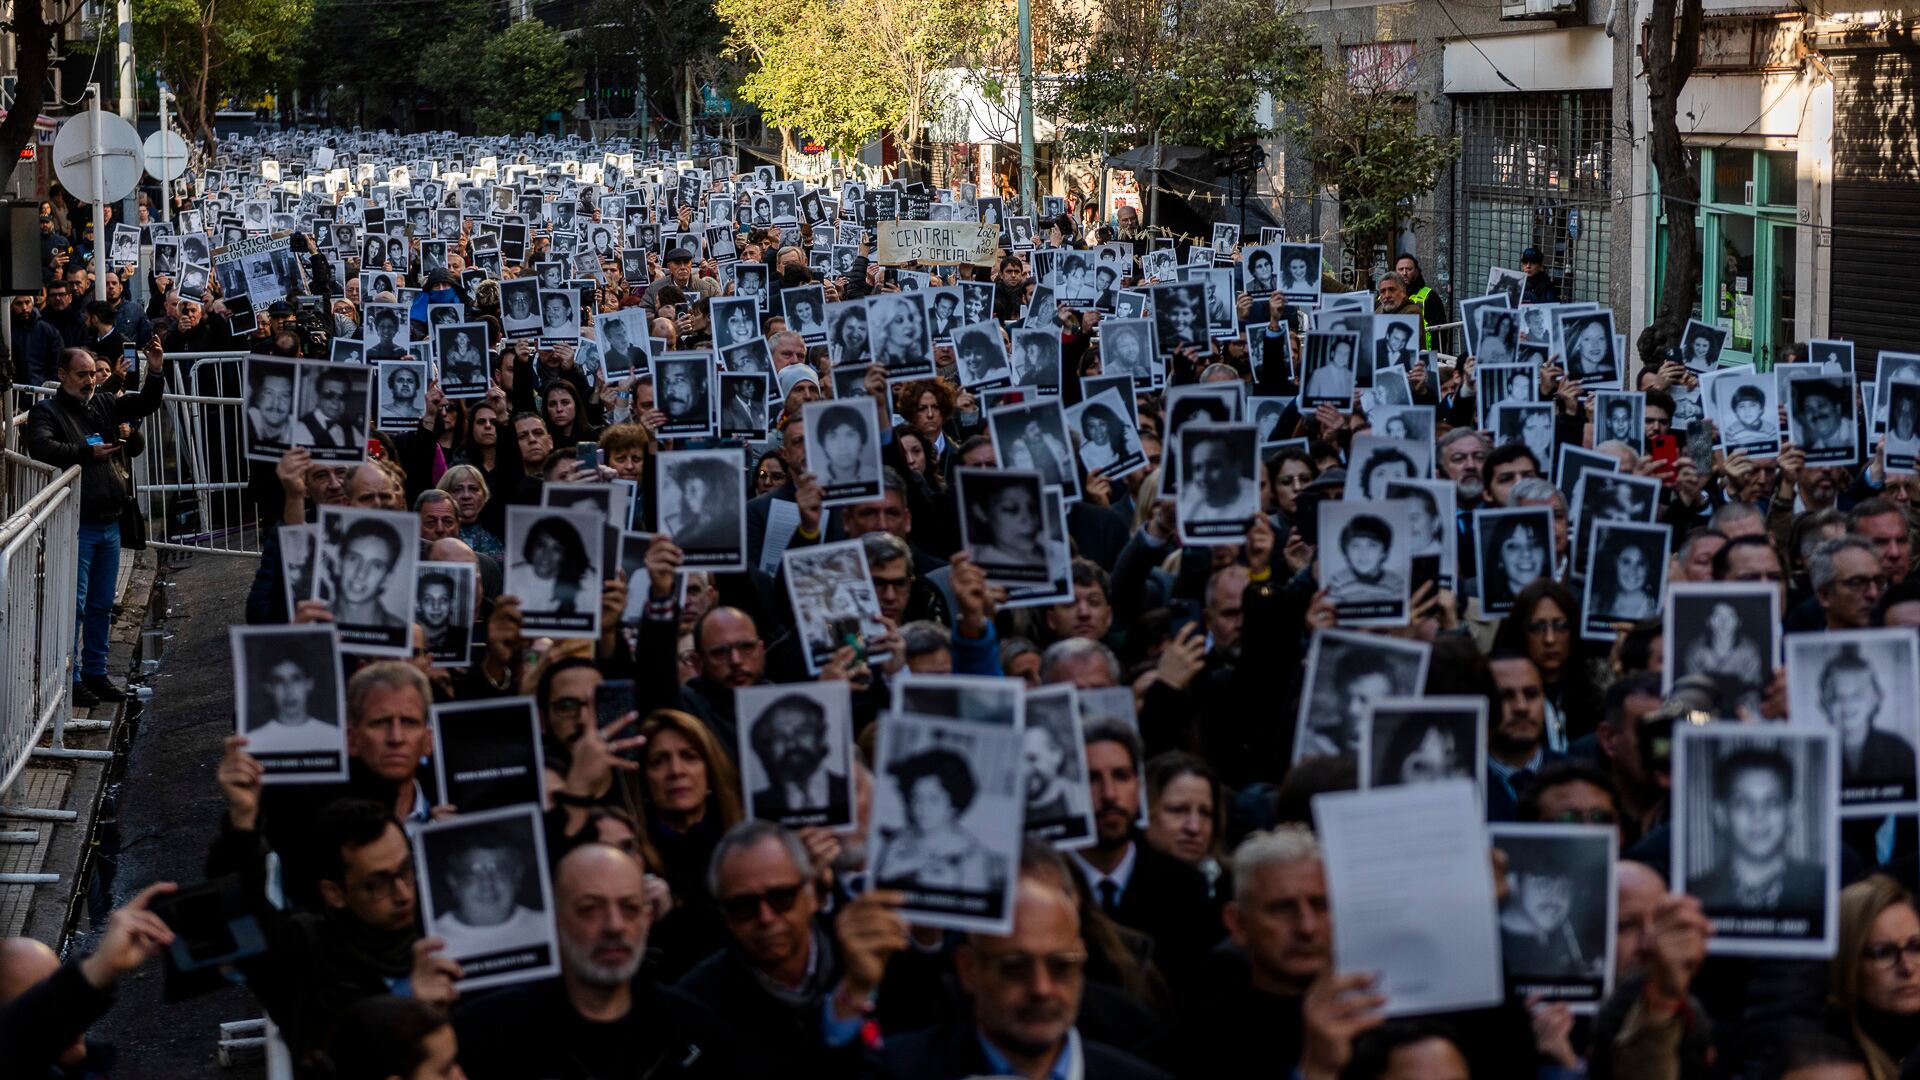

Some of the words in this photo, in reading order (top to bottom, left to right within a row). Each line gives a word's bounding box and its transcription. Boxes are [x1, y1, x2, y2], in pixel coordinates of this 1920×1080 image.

[976, 226, 996, 238] 2024
[229, 235, 273, 252] JUSTICIA
[213, 254, 230, 263] FUE
[230, 250, 243, 260] UN
[912, 247, 922, 259] ES
